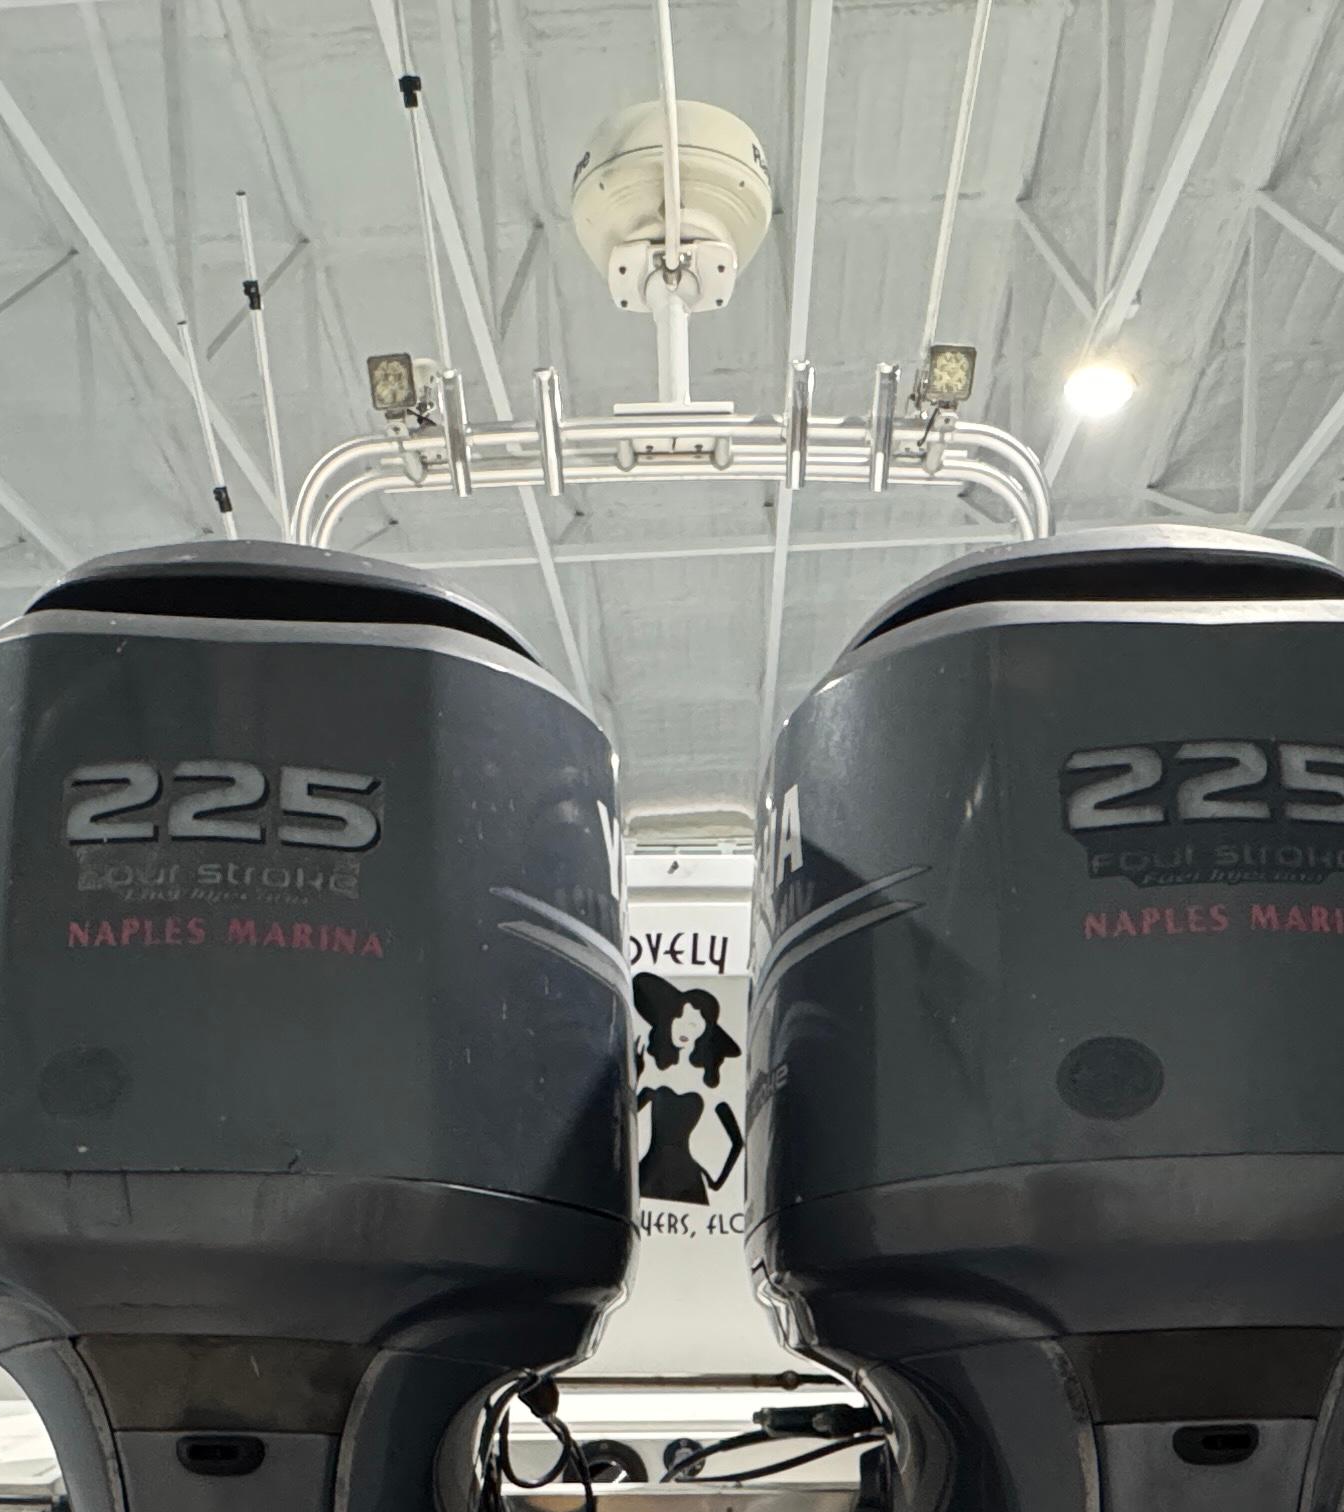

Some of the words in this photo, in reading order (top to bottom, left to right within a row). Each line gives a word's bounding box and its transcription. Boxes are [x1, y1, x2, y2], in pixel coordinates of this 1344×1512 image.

[67, 761, 382, 850] 225
[68, 917, 206, 947] NAPLES
[227, 917, 384, 957] MARINA
[1082, 904, 1230, 940] NAPLES
